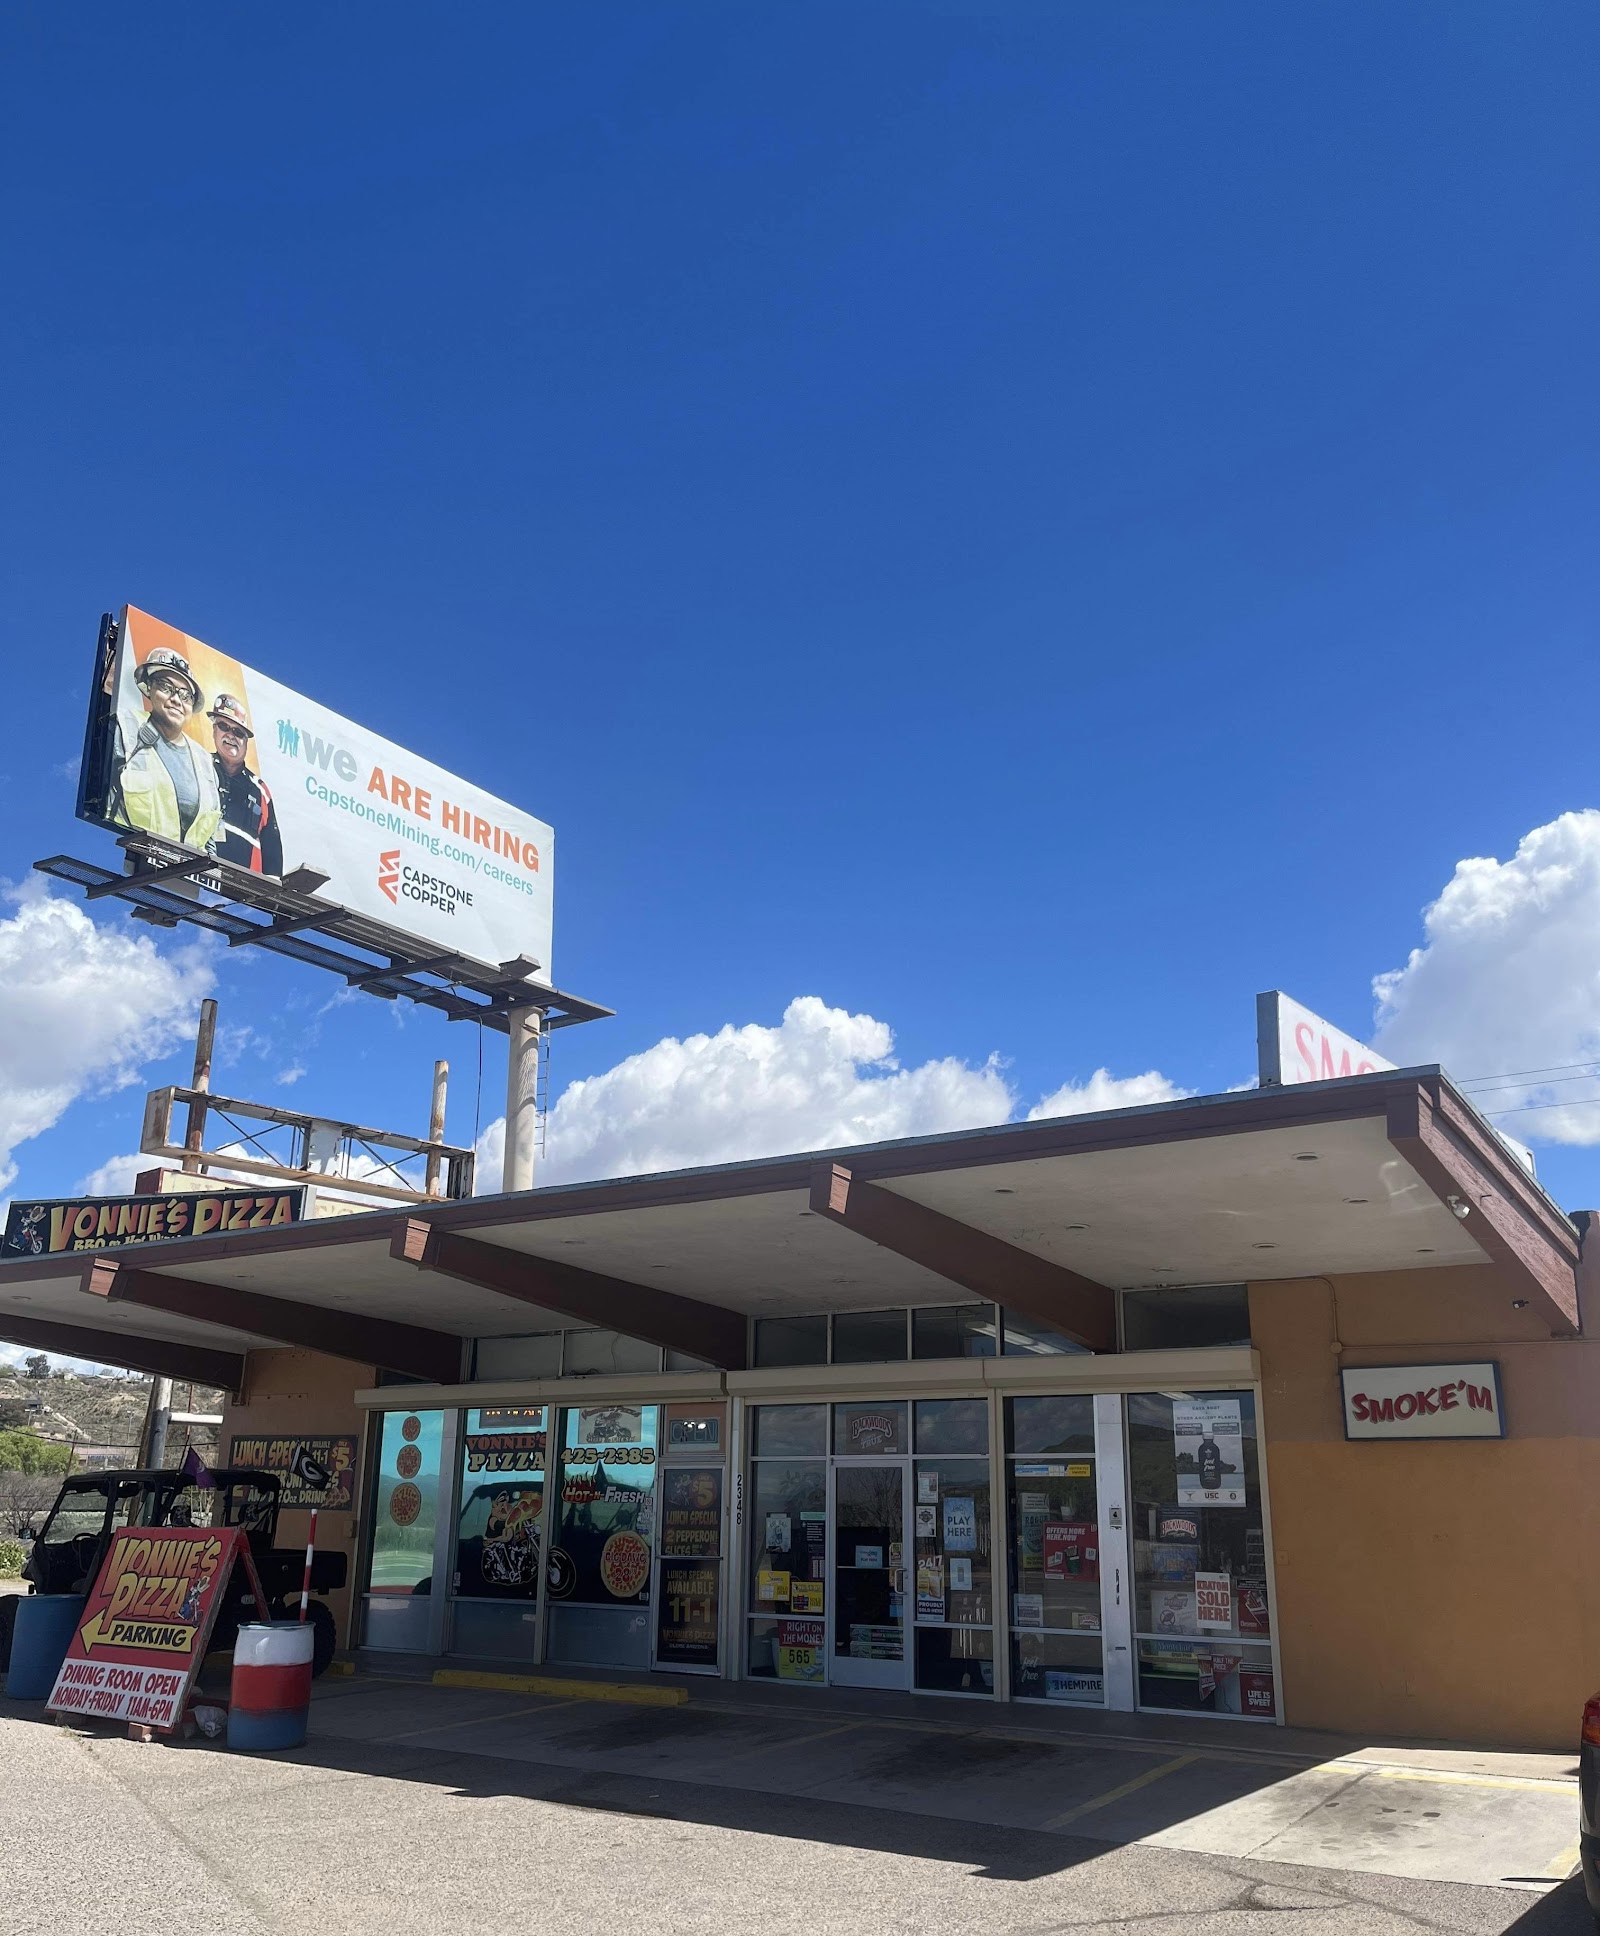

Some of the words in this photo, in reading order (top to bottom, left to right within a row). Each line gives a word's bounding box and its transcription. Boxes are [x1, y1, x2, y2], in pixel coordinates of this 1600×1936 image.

[301, 729, 358, 782] we
[367, 766, 432, 822] ARE
[442, 799, 540, 873] HIRING
[305, 775, 534, 896] CapstoneMining.com/careers
[402, 866, 474, 907] CAPSTONE
[401, 882, 456, 916] COPPER
[50, 1198, 189, 1252] VONNIE'S
[192, 1195, 293, 1236] PIZZA
[1351, 1379, 1494, 1424] SMOKE'M
[672, 1421, 716, 1441] OPEN
[232, 1440, 268, 1467] LUNCH
[331, 1446, 350, 1472] $5
[468, 1451, 546, 1472] PIZZA
[666, 1510, 689, 1525] LUNCH
[690, 1510, 719, 1526] SPECIAL
[947, 1515, 971, 1526] PLAY
[1160, 1518, 1198, 1538] BACKWOODS
[947, 1527, 972, 1537] HERE
[1046, 1526, 1068, 1535] OFFERS
[1069, 1527, 1086, 1535] MORE
[101, 1535, 222, 1597] VONNIE'S
[666, 1570, 687, 1580] LUNCH
[689, 1570, 714, 1581] SPECIAL
[666, 1581, 714, 1595] AVAILABLE
[1196, 1581, 1229, 1592] KRATOM
[99, 1572, 190, 1634] PIZZA
[1197, 1591, 1230, 1607] SOLD
[668, 1597, 711, 1624] 11-1
[1197, 1606, 1231, 1622] HERE
[111, 1624, 187, 1647] PARKING
[787, 1621, 812, 1633] RIGHT
[811, 1624, 822, 1633] ON
[782, 1633, 797, 1644] THE
[788, 1650, 810, 1664] 565
[61, 1664, 107, 1688] DINING
[105, 1668, 145, 1693] ROOM
[145, 1673, 182, 1696] OPEN
[1060, 1680, 1102, 1691] HEMPIRE
[51, 1686, 126, 1715] MONDAY-FRIDAY
[126, 1695, 174, 1722] 11AM-6PM
[1247, 1690, 1262, 1699] LIFE
[1262, 1690, 1271, 1699] IS
[1248, 1699, 1271, 1707] SWEET
